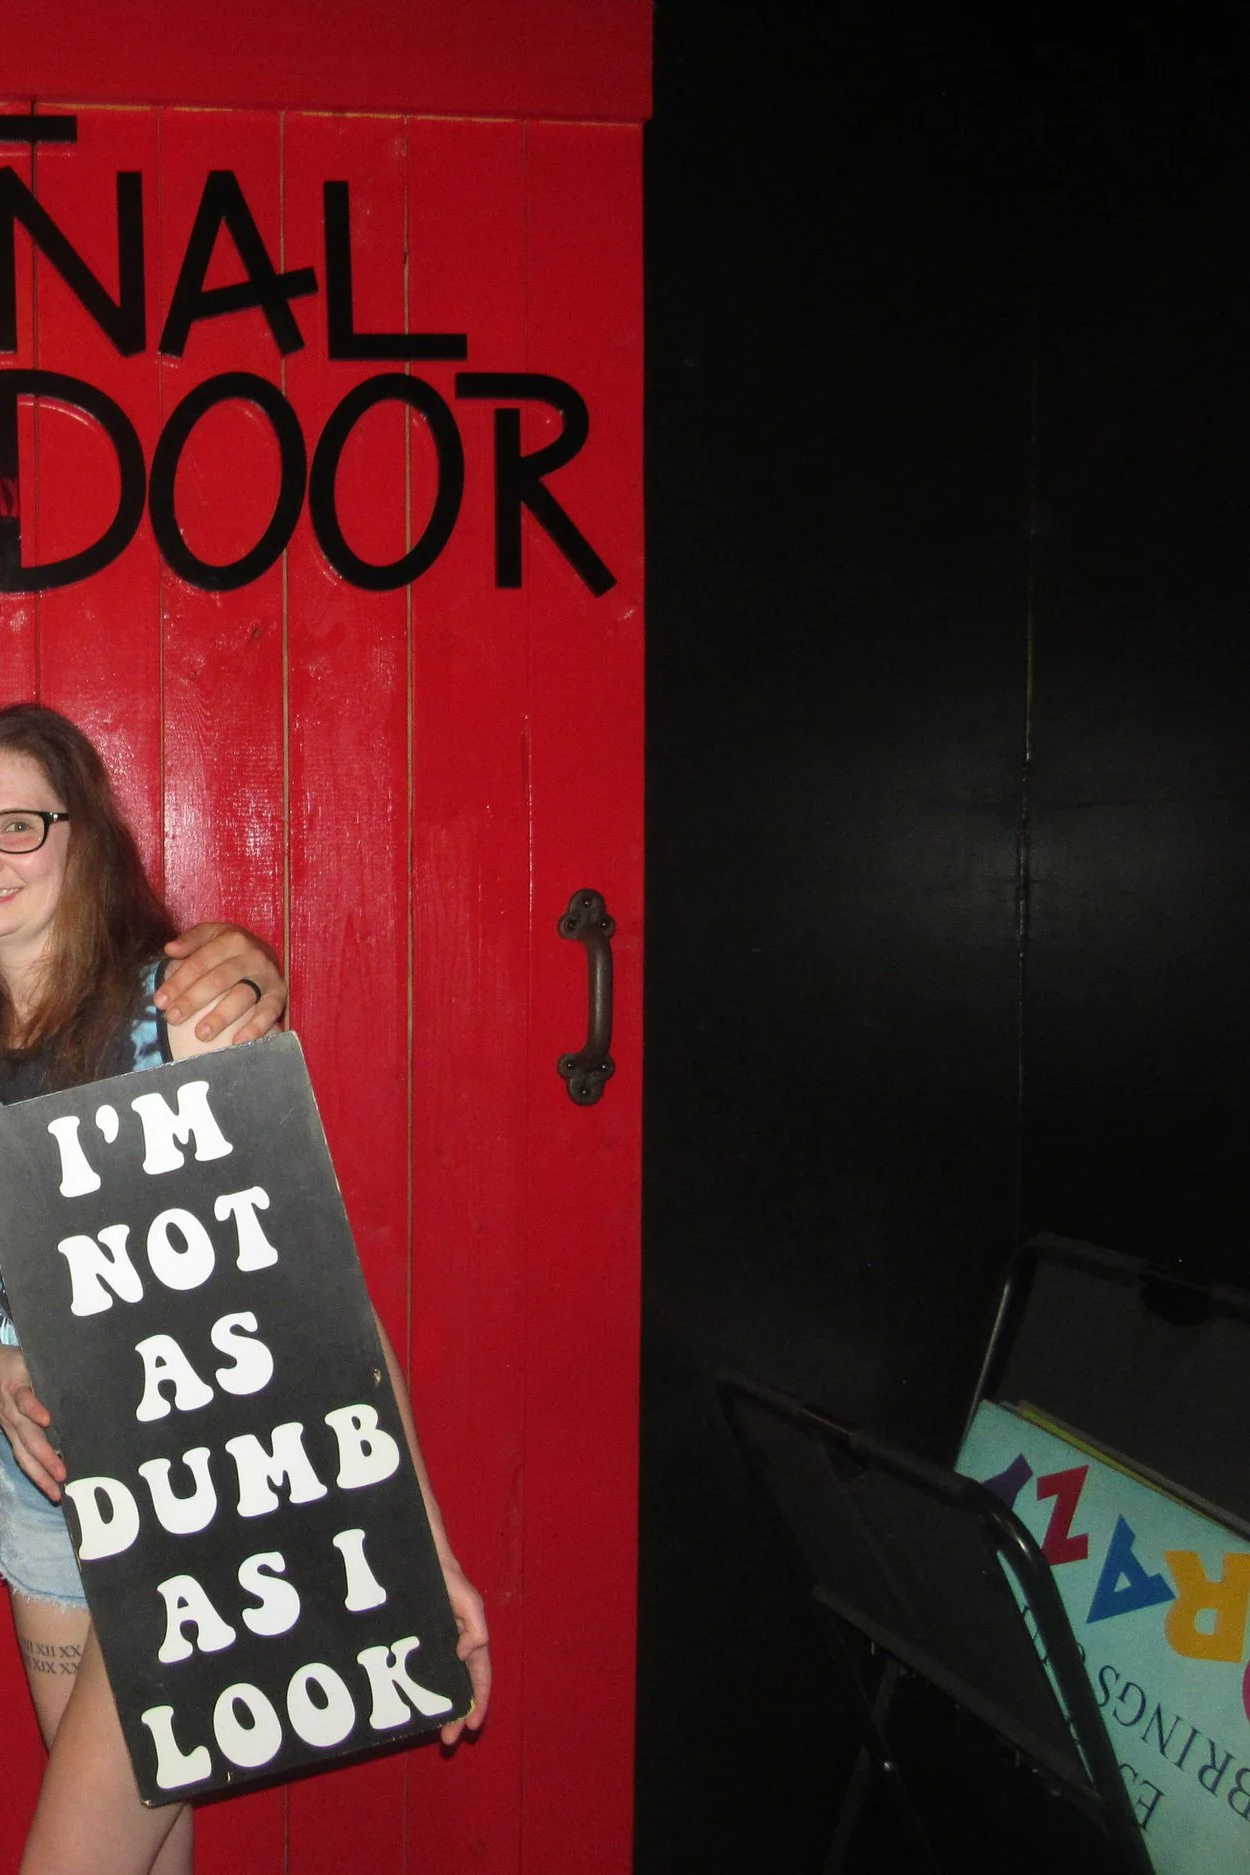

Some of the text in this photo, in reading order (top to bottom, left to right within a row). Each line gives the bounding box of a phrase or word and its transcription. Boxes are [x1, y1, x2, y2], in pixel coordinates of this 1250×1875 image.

[48, 1080, 233, 1198] I'M
[57, 1186, 279, 1317] NOT
[135, 1311, 275, 1422] AS
[64, 1404, 401, 1560] DUMB
[156, 1528, 387, 1664] AS I
[981, 1453, 1250, 1722] RAZY
[141, 1636, 453, 1790] LOOK
